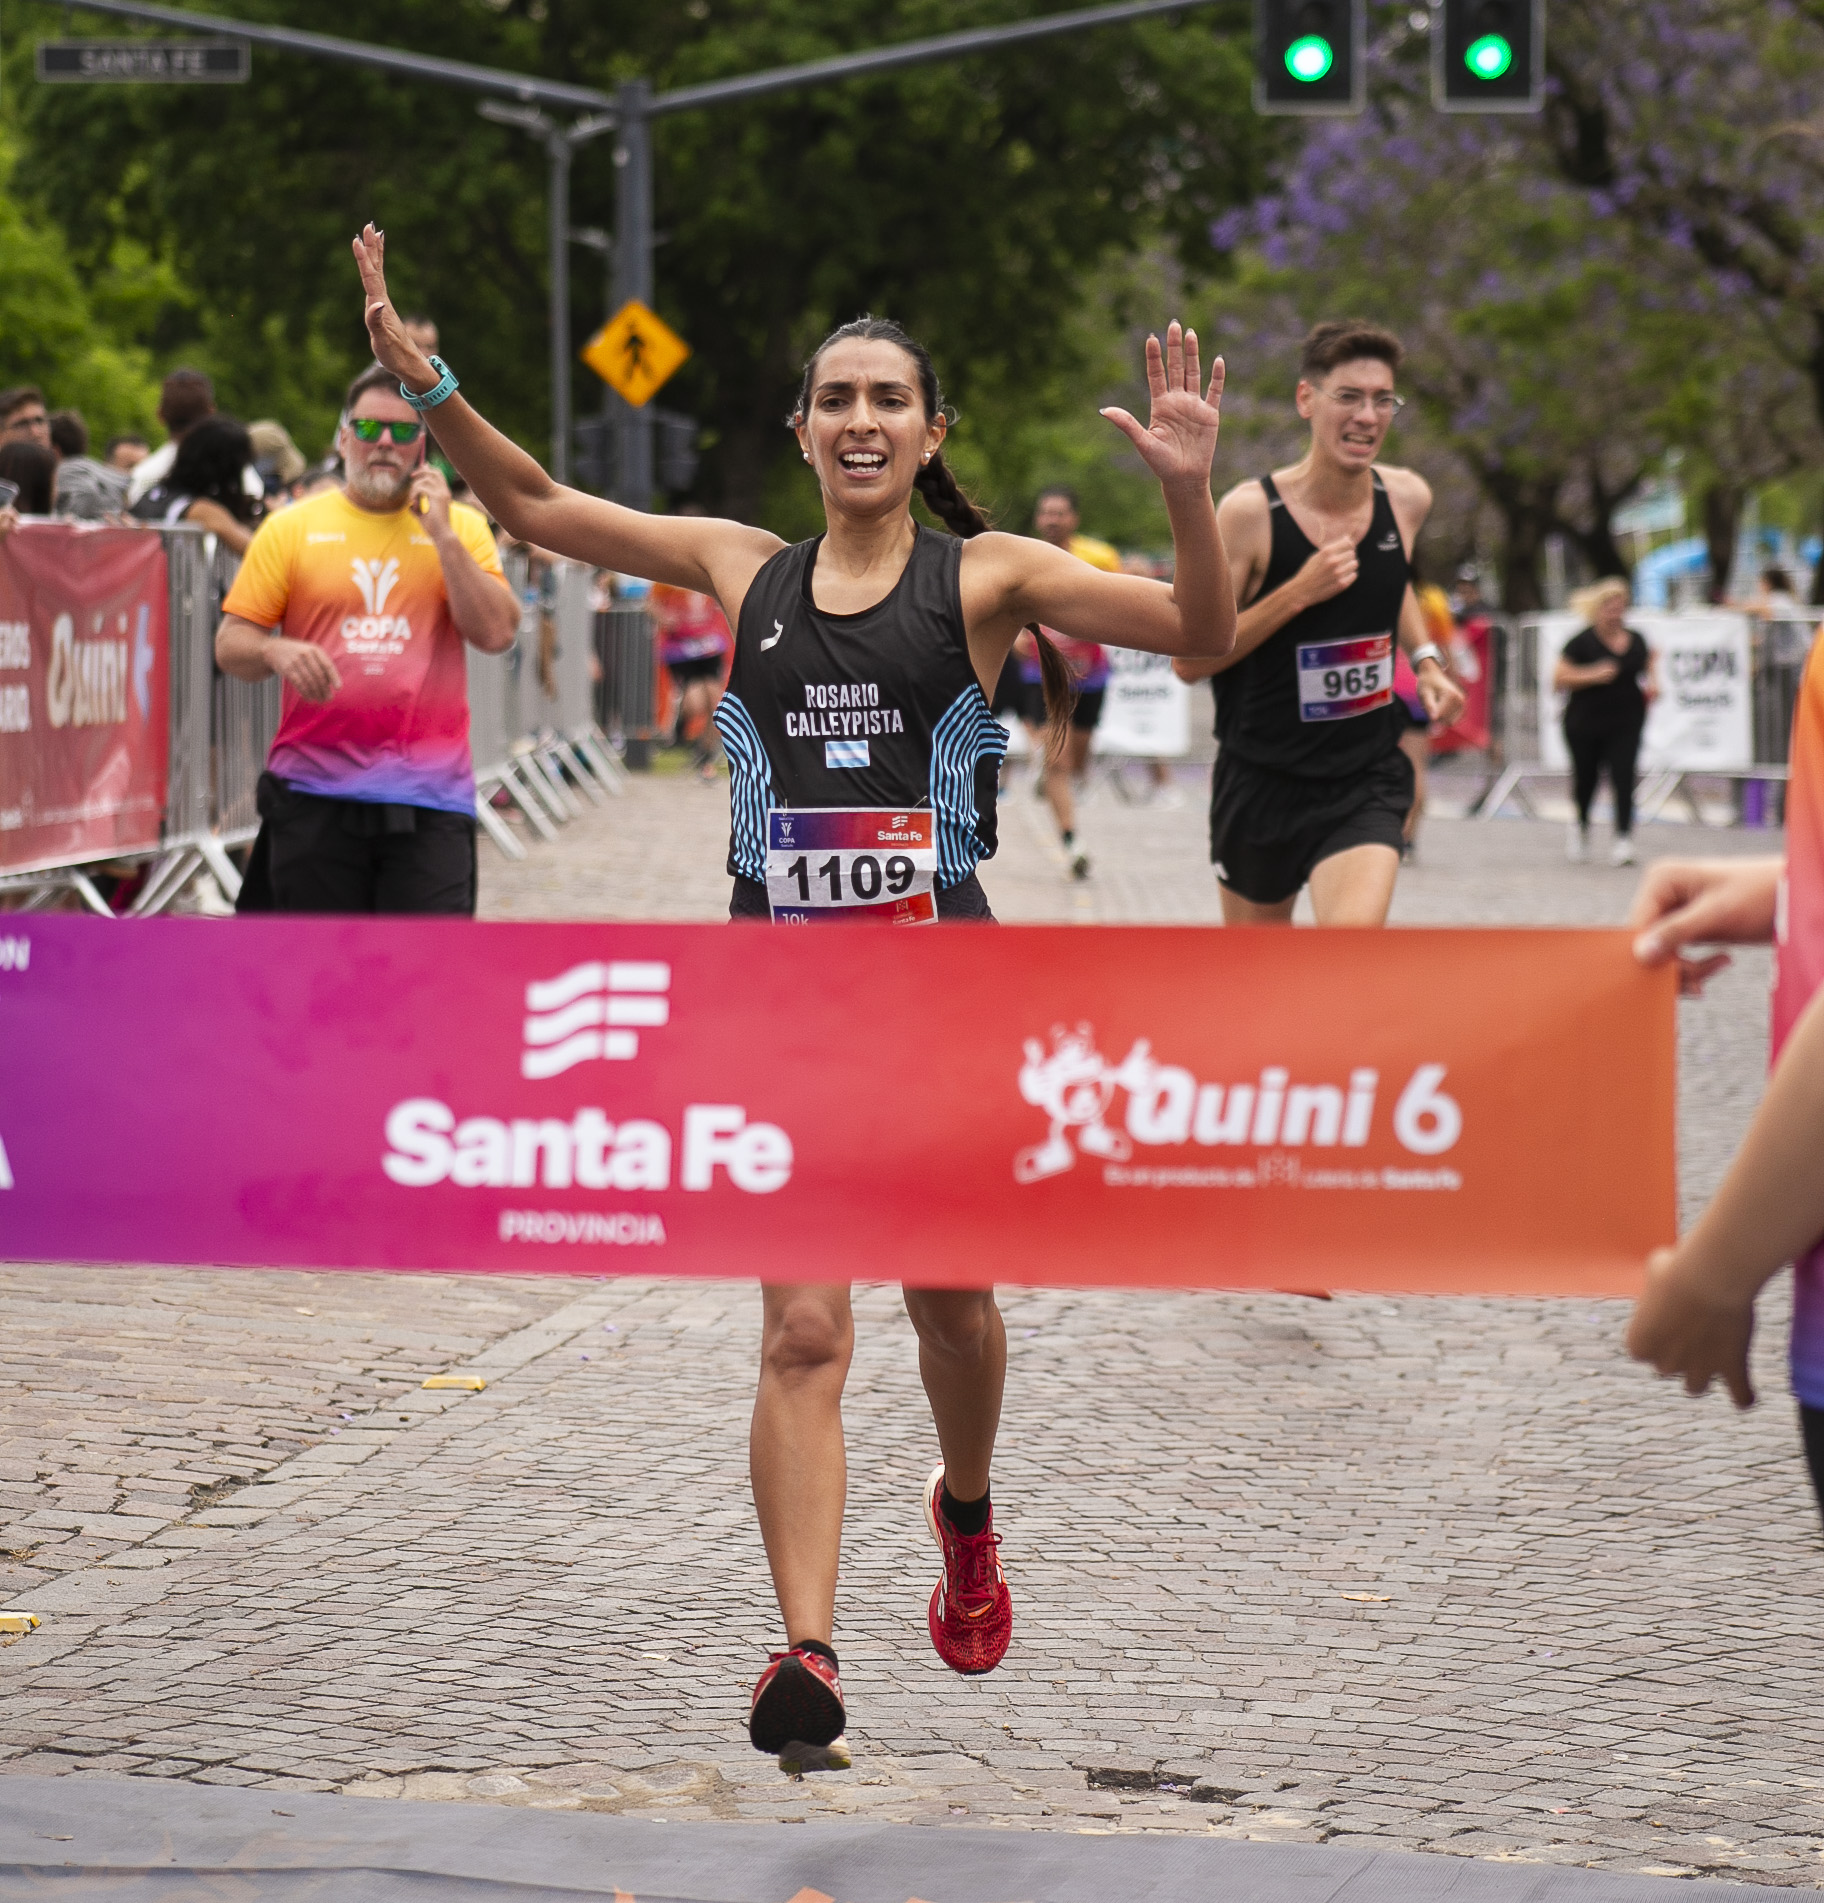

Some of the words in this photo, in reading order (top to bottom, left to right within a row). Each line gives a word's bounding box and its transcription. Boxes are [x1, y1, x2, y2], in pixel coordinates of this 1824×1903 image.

[341, 616, 412, 640] COPA
[48, 611, 128, 729] Quini
[1323, 664, 1380, 699] 965
[805, 683, 879, 708] ROSARIO
[786, 709, 904, 736] CALLEYPISTA
[877, 830, 909, 841] Santa
[910, 831, 923, 842] Fe
[788, 855, 916, 901] 1109
[783, 913, 809, 926] 10k
[1126, 1064, 1379, 1147] Quini
[1393, 1062, 1463, 1156] 6
[382, 1097, 672, 1191] Santa
[681, 1103, 794, 1194] Fe
[500, 1210, 667, 1246] PROVINCIA
